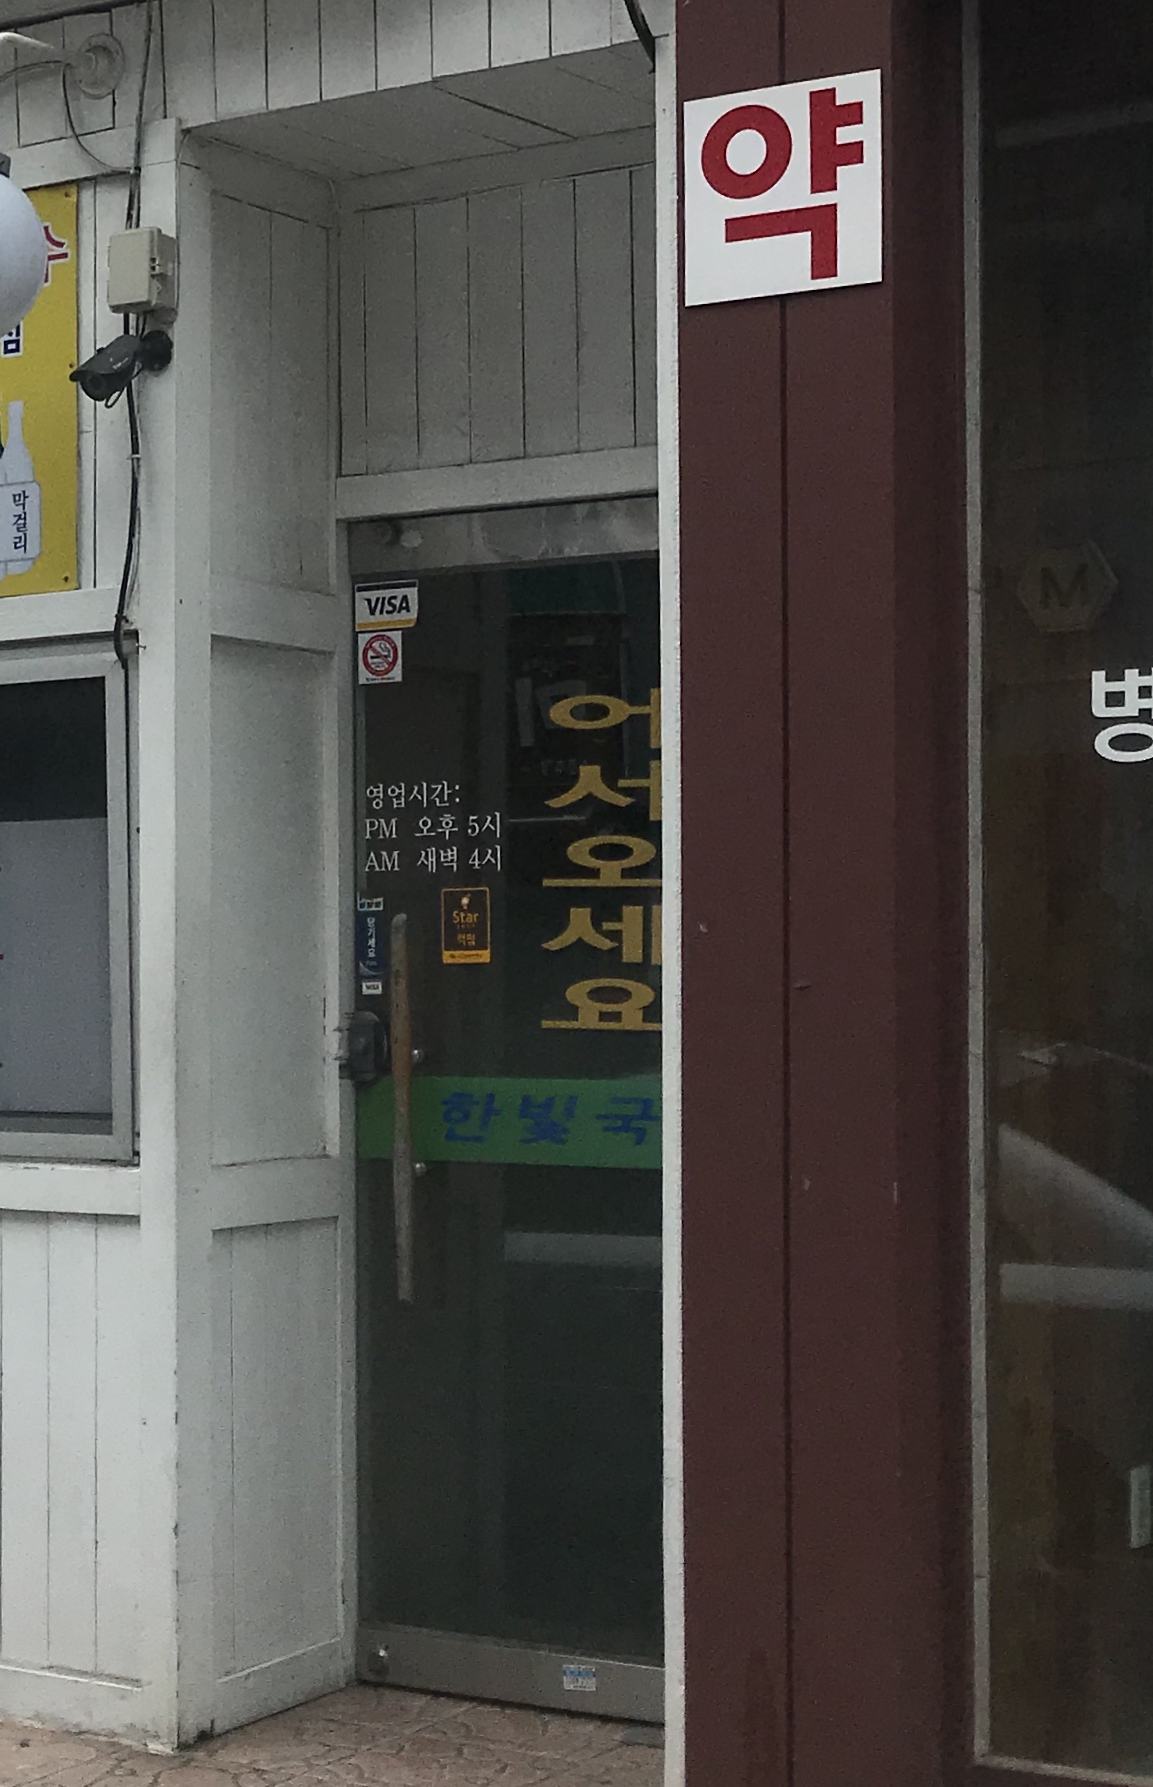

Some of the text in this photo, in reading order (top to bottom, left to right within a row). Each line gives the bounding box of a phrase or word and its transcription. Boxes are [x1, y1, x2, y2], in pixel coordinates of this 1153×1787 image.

[700, 86, 865, 280] 약
[12, 488, 29, 555] 막걸리
[363, 595, 411, 616] VISA
[366, 781, 460, 810] 영업시간:
[365, 812, 501, 840] PM 오후 5시
[365, 845, 501, 873] AM 새벽 4시
[541, 687, 662, 1032] 어서오세요
[452, 910, 479, 924] Star
